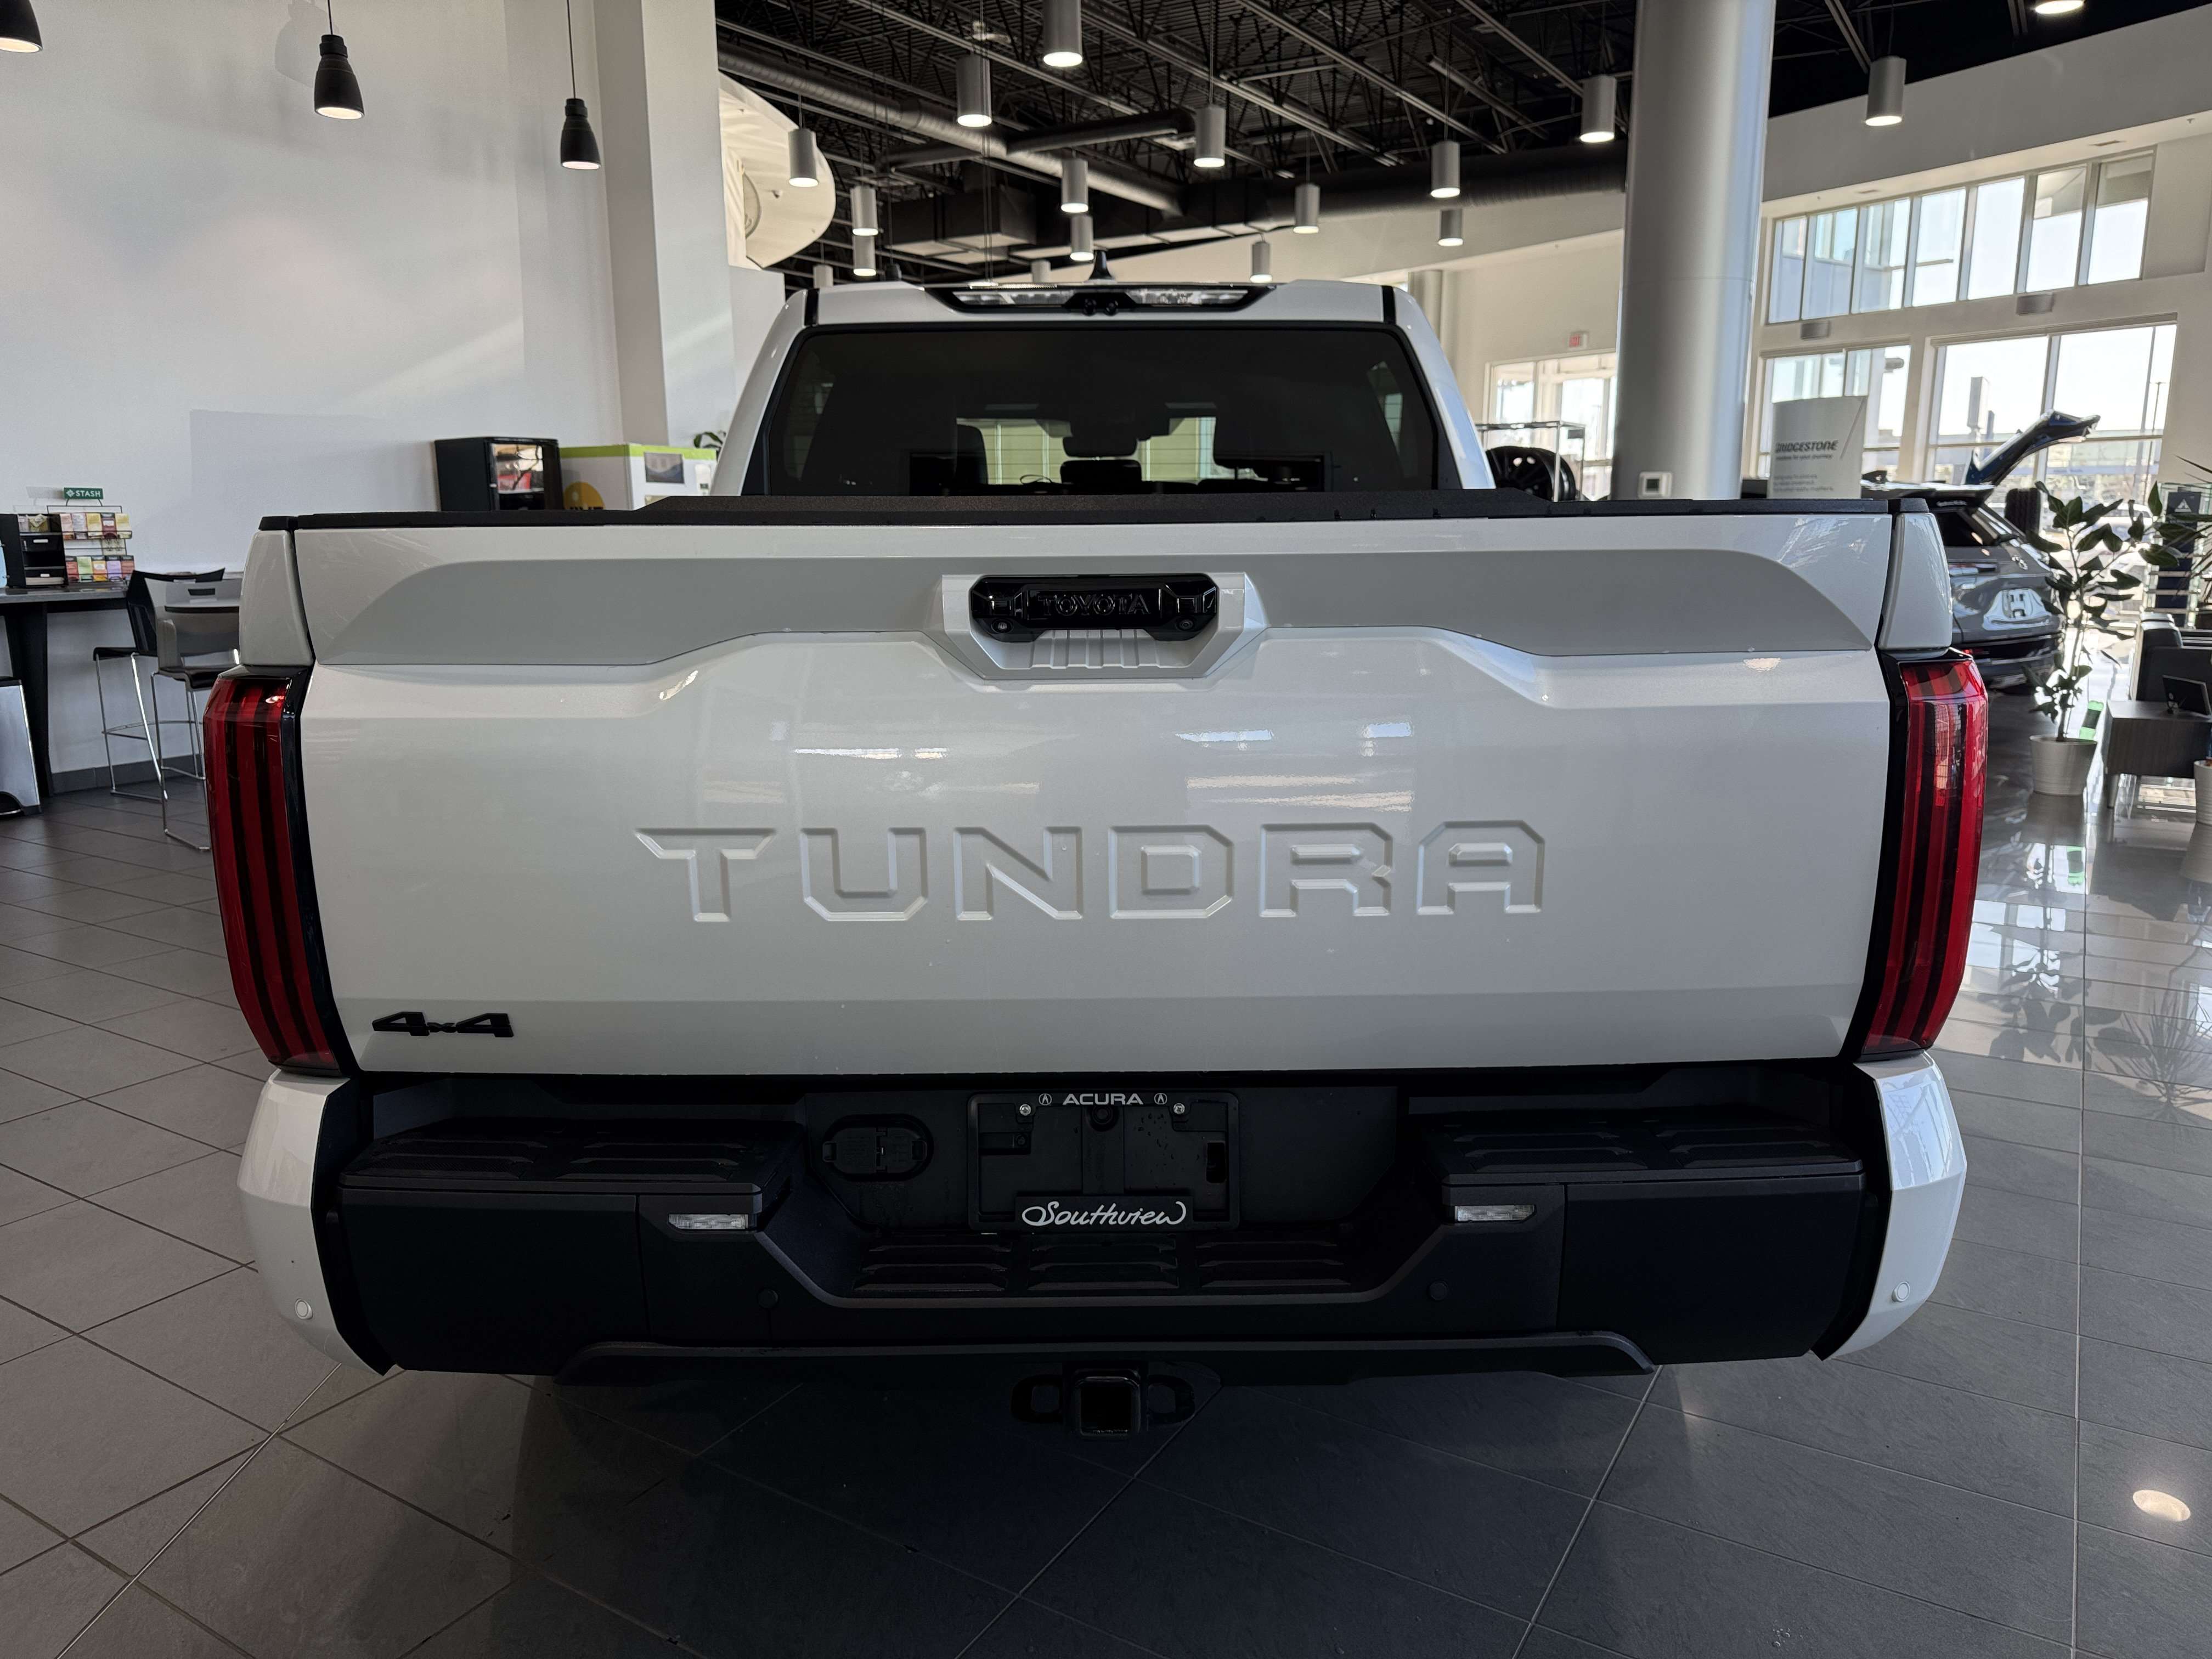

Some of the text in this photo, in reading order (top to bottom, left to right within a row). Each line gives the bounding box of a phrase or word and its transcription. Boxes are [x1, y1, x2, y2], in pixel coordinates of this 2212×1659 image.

[1037, 594, 1151, 616] TOYOTA
[634, 820, 1546, 922] TUNDRA
[1062, 1093, 1144, 1105] ACURA
[1021, 1201, 1187, 1227] Southview
